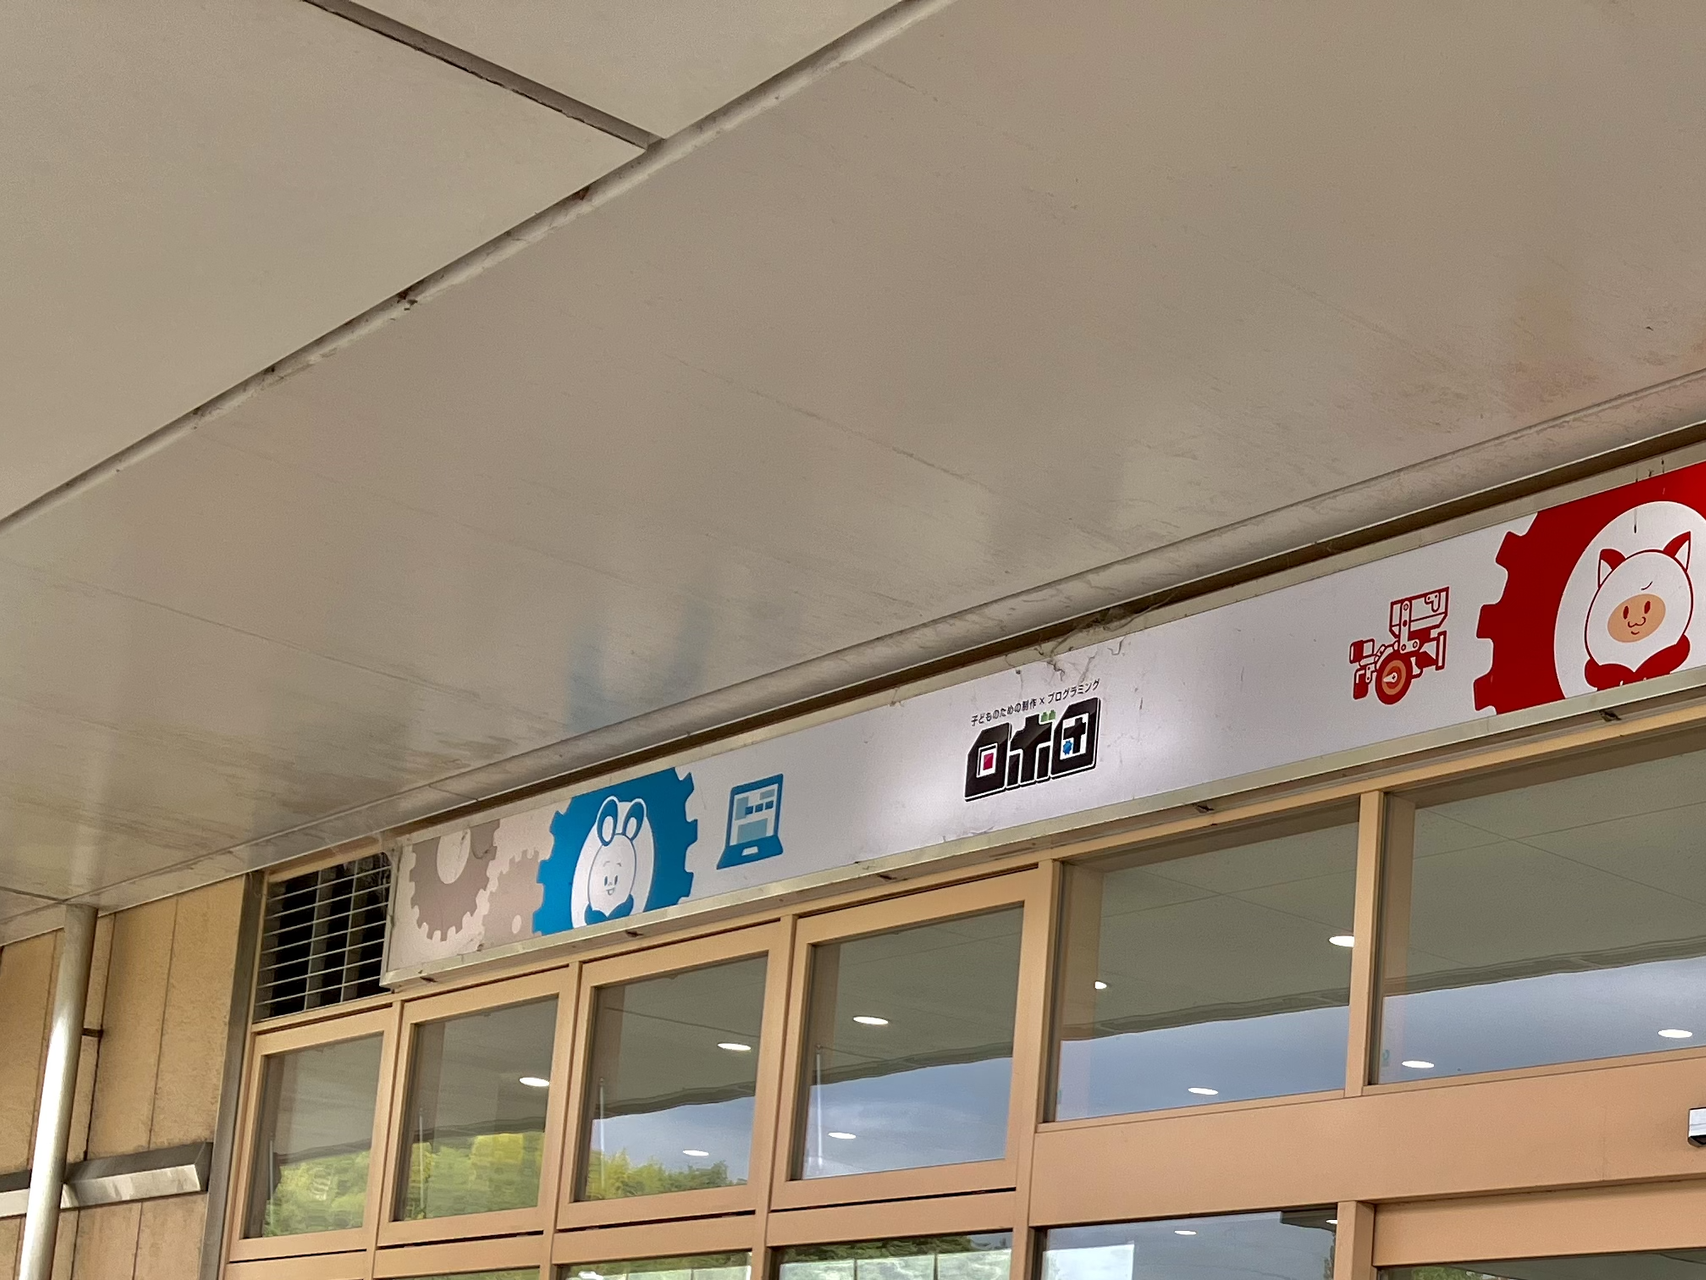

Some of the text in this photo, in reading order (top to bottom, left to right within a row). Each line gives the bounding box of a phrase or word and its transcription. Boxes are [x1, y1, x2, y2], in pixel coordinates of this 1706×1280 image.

[970, 697, 1037, 728] 子どものための制作
[1047, 678, 1101, 706] プログラミング
